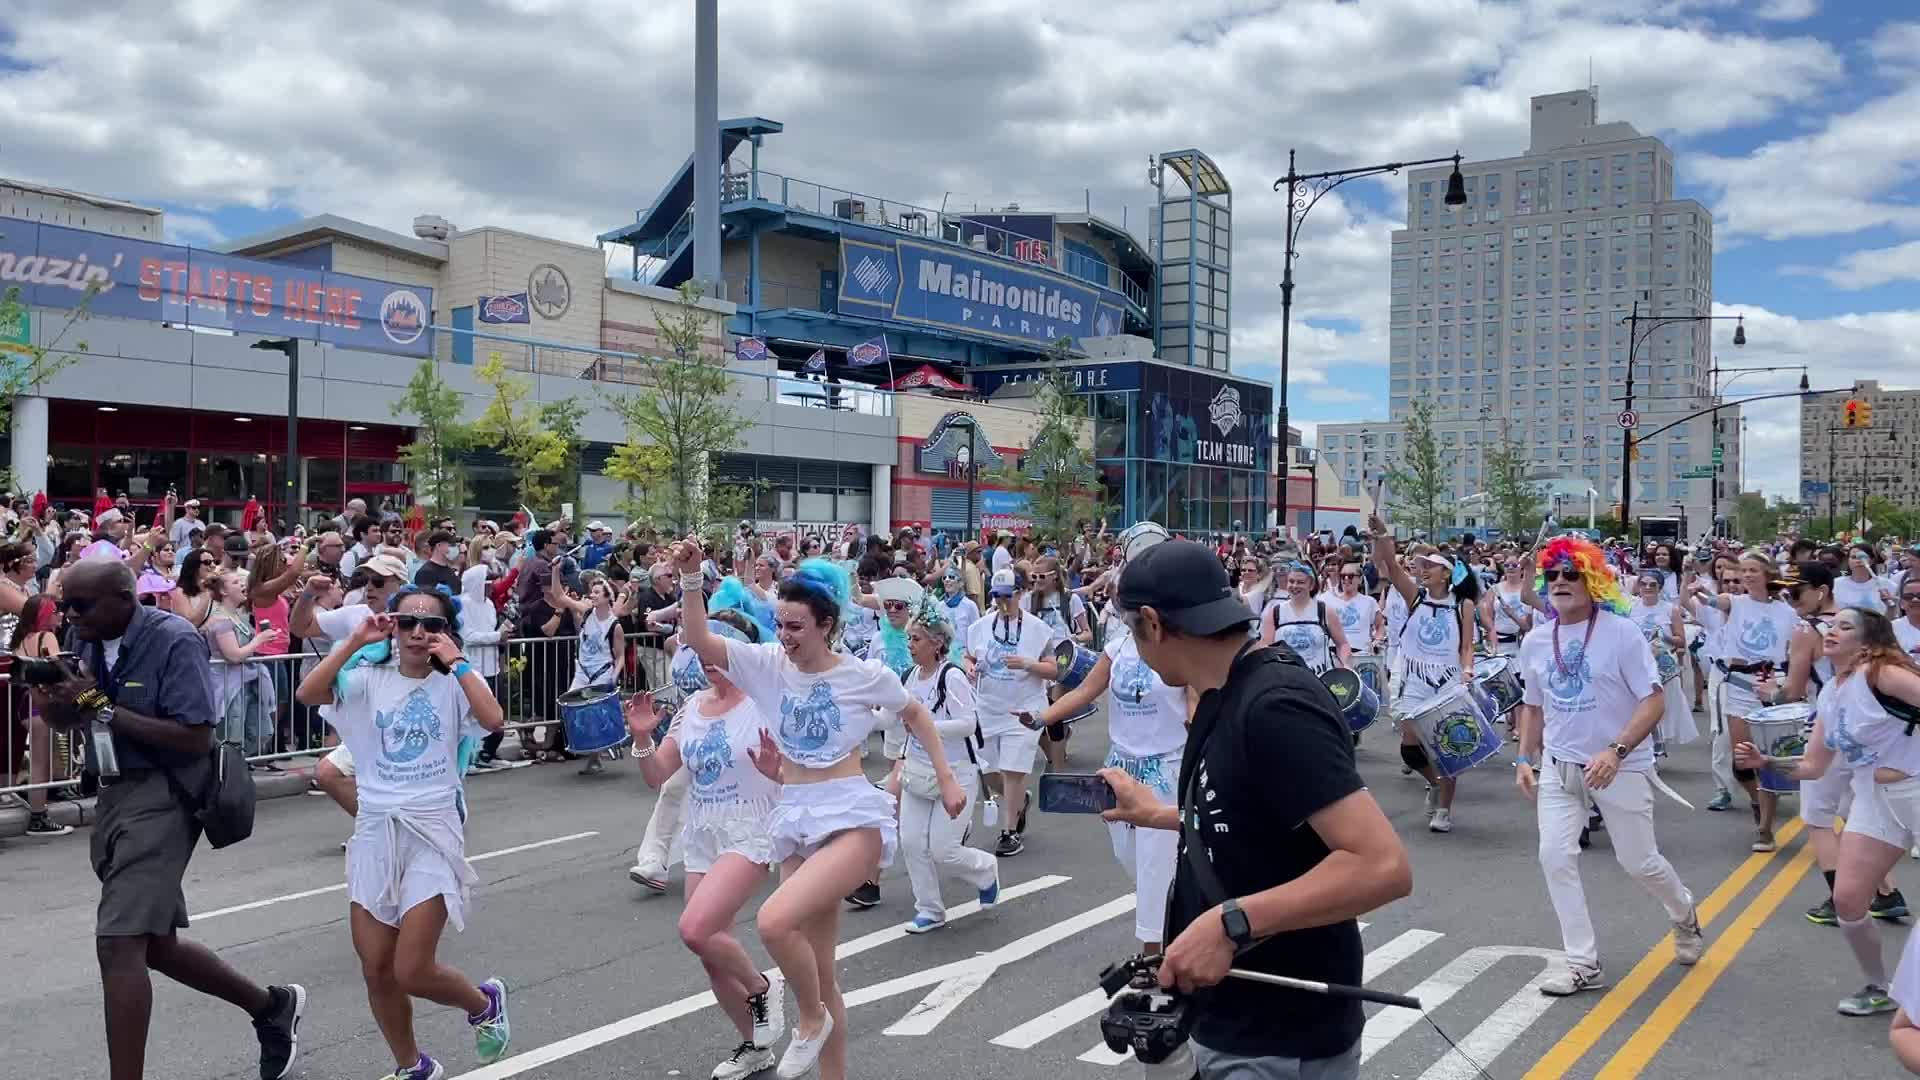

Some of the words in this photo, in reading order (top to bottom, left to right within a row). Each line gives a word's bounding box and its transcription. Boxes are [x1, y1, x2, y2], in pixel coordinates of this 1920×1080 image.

[139, 257, 273, 317] STARTS
[283, 279, 363, 330] HERE
[918, 259, 1082, 325] Maimonides
[1049, 369, 1108, 388] TORE
[1196, 439, 1223, 462] TEAM
[1226, 443, 1255, 465] STORE
